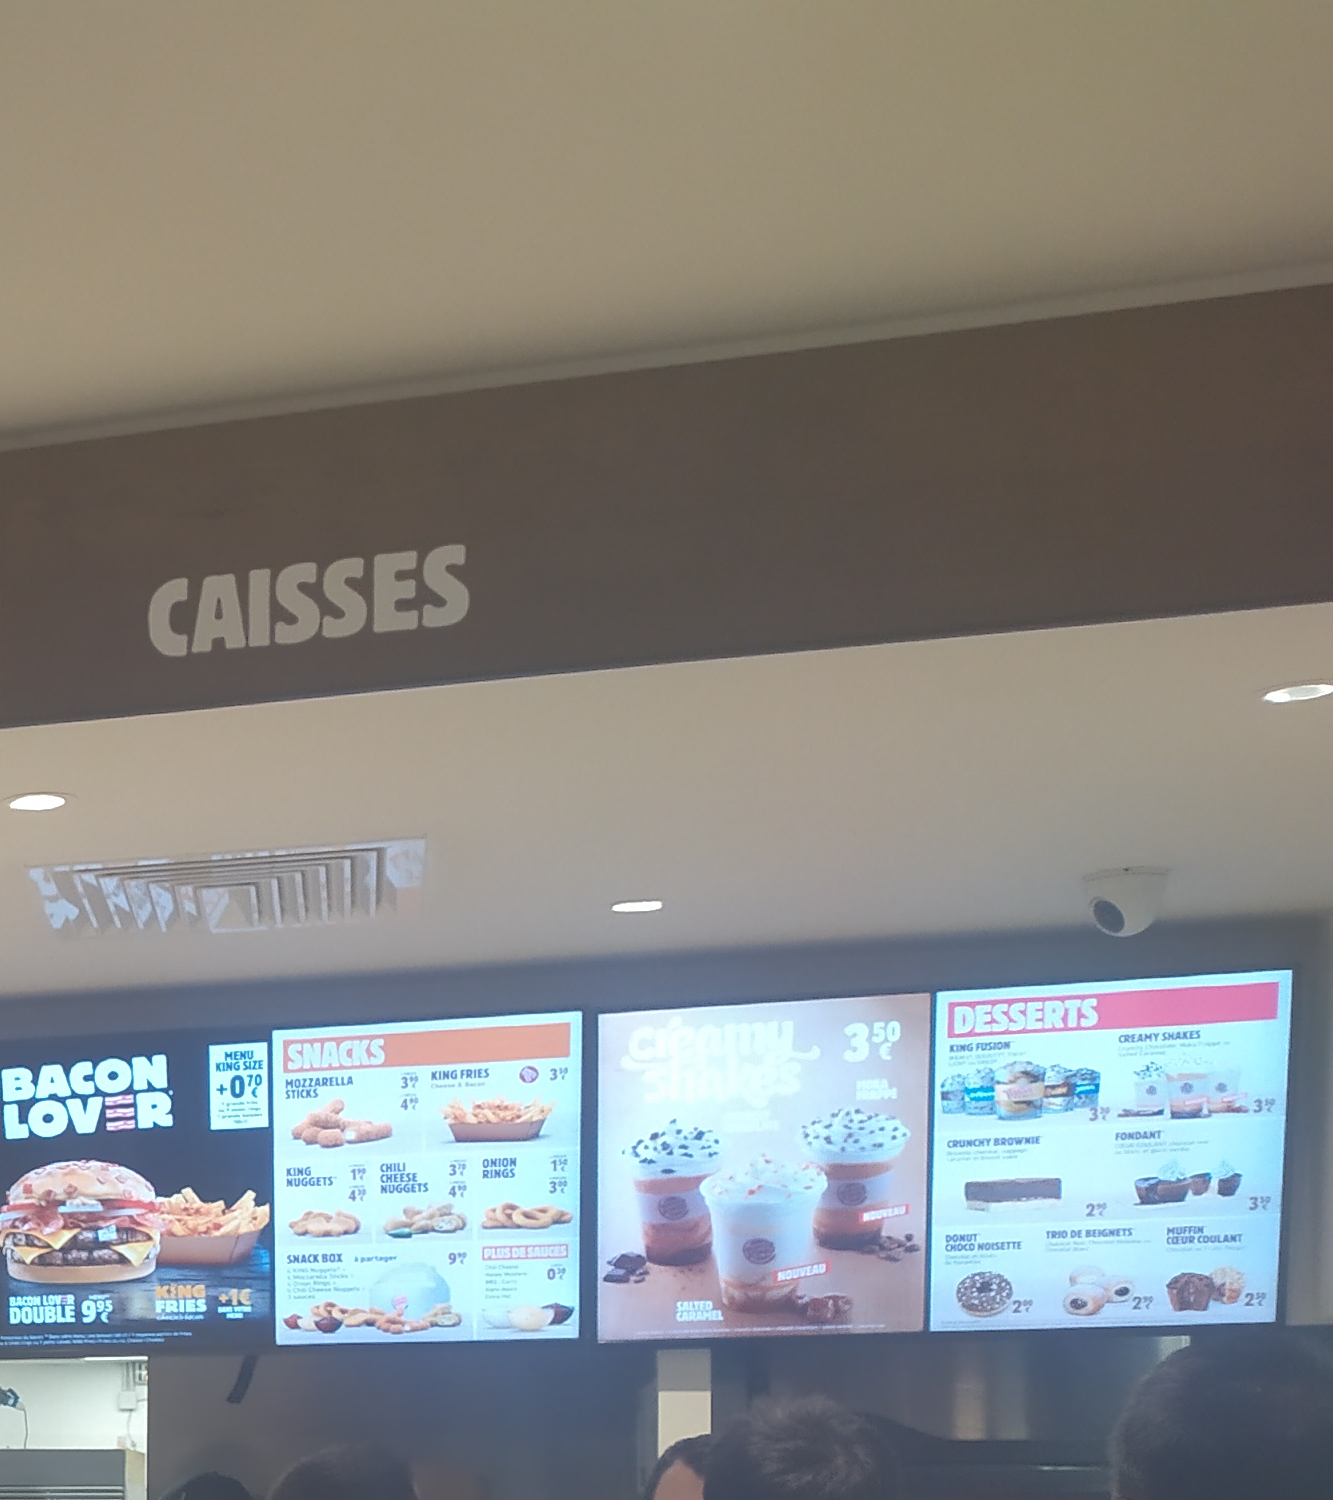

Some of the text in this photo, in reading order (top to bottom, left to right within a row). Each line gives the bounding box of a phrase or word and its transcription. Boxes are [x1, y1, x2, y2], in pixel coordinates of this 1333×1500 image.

[148, 544, 470, 657] CAISSES
[953, 999, 1099, 1035] DESSERTS
[1119, 1030, 1201, 1044] CREAMY SHAKES
[950, 1041, 1011, 1052] KING FUSION
[225, 1051, 253, 1061] MENU
[287, 1039, 385, 1070] SNACKS
[216, 1060, 263, 1072] KING SIZE
[1, 1054, 168, 1102] BACON
[431, 1068, 490, 1081] KING FRIES
[285, 1076, 354, 1089] MOZZARELLA
[285, 1088, 319, 1100] STICKS
[3, 1091, 174, 1140] LOVER
[1115, 1130, 1162, 1141] FONDANT
[947, 1136, 1041, 1148] CRUNCHY BROWNIE
[380, 1163, 406, 1173] CHILI
[482, 1157, 517, 1169] ONION
[286, 1167, 311, 1177] KING
[380, 1172, 418, 1183] CHEESE
[482, 1168, 516, 1179] RINGS
[286, 1177, 333, 1188] NUGGETS
[380, 1183, 428, 1194] NUGGETS
[1046, 1228, 1132, 1239] TRIO DE BEIGNETS
[1167, 1226, 1204, 1236] MUFFIN
[945, 1233, 977, 1243] DONUT
[1197, 1233, 1242, 1244] COULANT
[945, 1241, 1022, 1252] CHOCO NOISETTE
[287, 1254, 319, 1264] SNACK
[321, 1253, 343, 1263] BOX
[484, 1248, 511, 1259] PLUS
[155, 1285, 206, 1299] KING
[9, 1295, 75, 1307] BACON LOVER
[155, 1298, 207, 1314] FRIES
[676, 1301, 712, 1311] SALTED
[9, 1305, 76, 1324] DOUBLE
[676, 1310, 723, 1322] CARAMEL
